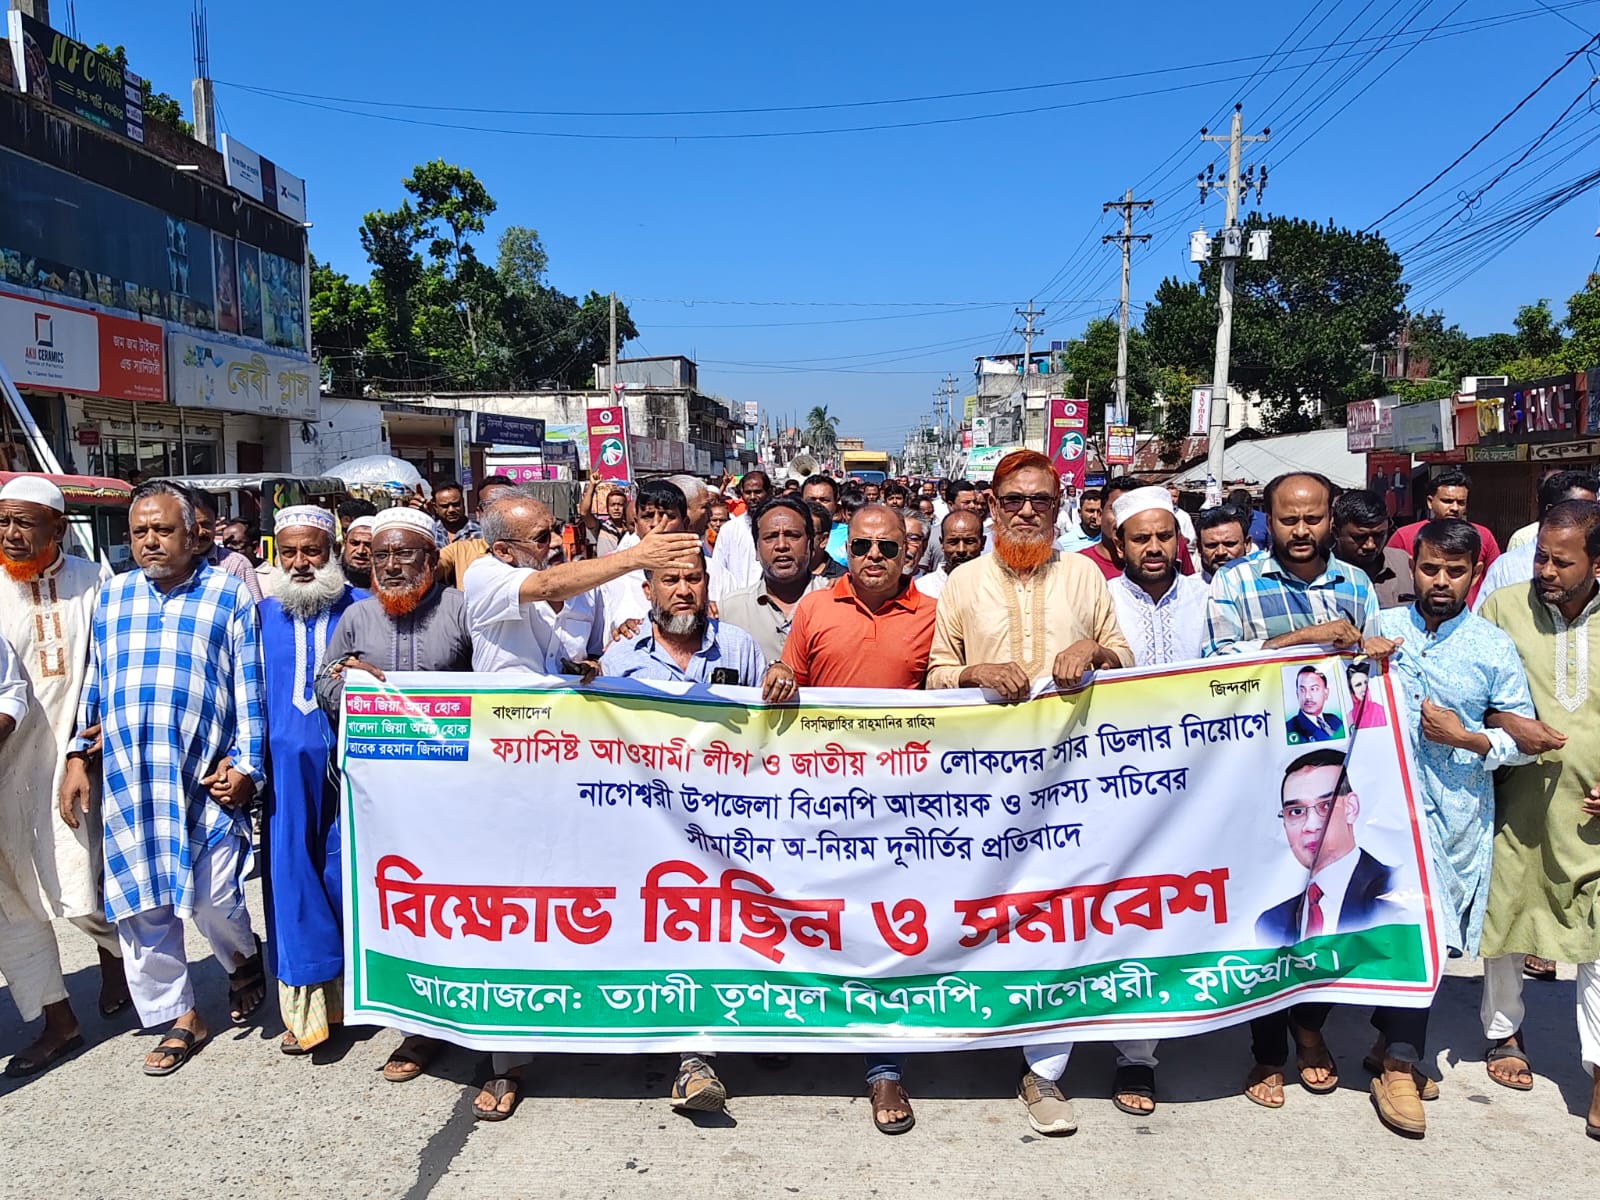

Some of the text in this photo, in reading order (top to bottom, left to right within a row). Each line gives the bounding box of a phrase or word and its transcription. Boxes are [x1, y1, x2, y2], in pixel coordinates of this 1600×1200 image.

[38, 348, 64, 364] CERAMICS
[1523, 384, 1572, 433] FACE
[1209, 677, 1261, 698] জিন্দবাদ
[374, 698, 400, 713] জিয়া
[434, 701, 461, 715] হোক
[493, 705, 552, 721] বাংলাদেশ
[381, 719, 407, 735] জিয়া
[441, 723, 468, 737] হোক
[905, 713, 936, 730] রাহিম
[348, 740, 464, 757] তারেক রহমান জিন্দাবাদ
[490, 709, 1272, 778] ফ্যাসিষ্ট আওয়ামী লীগ ও জাতীয় পার্টি লোকদের সার ডিলার নিয়োগে
[577, 764, 1190, 821] নাগেশ্বরী উপজেলা বিএনপি আহ্বায়ক ও সদস্য সচিবের
[684, 822, 776, 862] সীমাহীন
[782, 829, 878, 862] অ-নিয়ম
[981, 822, 1083, 862] প্রতিবাদে
[374, 854, 1230, 965] বিক্ষোভ মিছিল ও সমাবেশ
[407, 972, 583, 1014] আয়োজনে:
[597, 973, 703, 1015] ত্যাগী
[711, 981, 829, 1025] তৃণমূল
[841, 971, 992, 1021] বিএনপি,
[1003, 962, 1171, 1010] নাগেশ্বরী,
